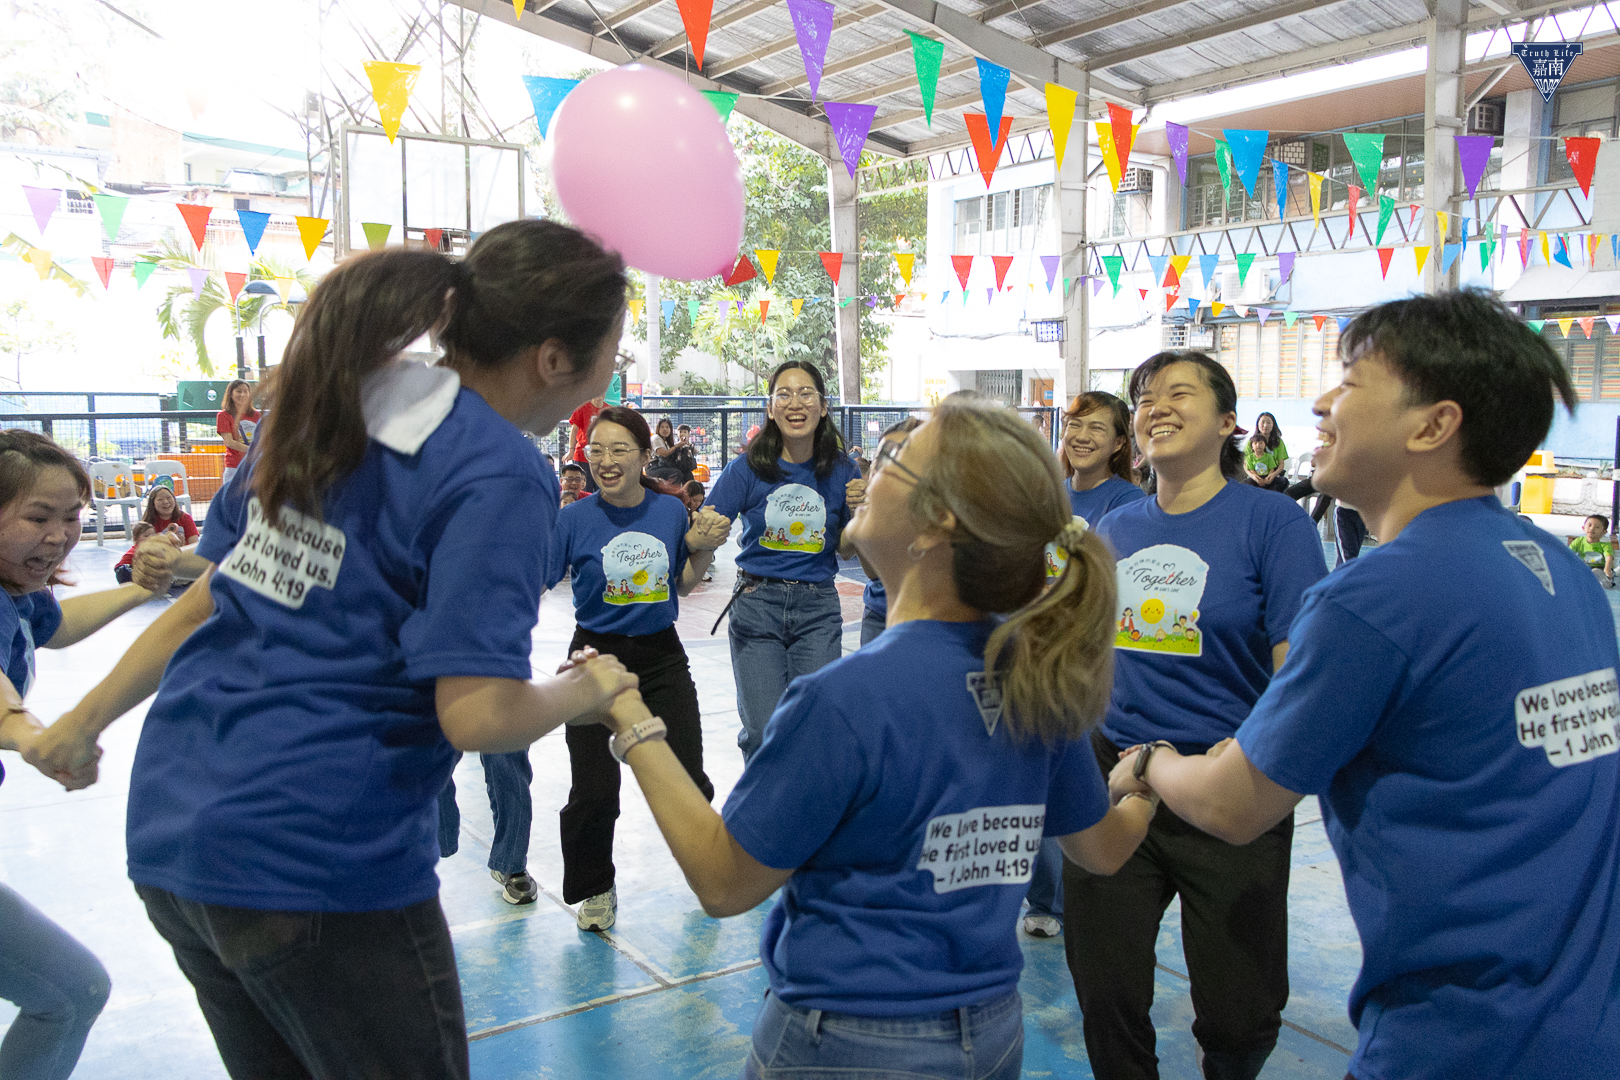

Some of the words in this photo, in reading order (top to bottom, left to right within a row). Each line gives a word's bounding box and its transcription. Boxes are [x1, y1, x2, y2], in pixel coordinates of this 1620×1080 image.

[779, 501, 821, 517] Together
[261, 534, 304, 571] loved
[305, 561, 333, 586] us.
[616, 547, 663, 567] Together
[231, 553, 267, 585] John
[271, 570, 305, 600] 4:19
[1133, 567, 1198, 591] Together
[1521, 694, 1549, 714] We
[1551, 688, 1585, 707] love
[1520, 721, 1546, 741] He
[1551, 710, 1587, 734] first
[1586, 705, 1620, 723] love
[930, 822, 952, 839] We
[974, 834, 1019, 856] loved
[995, 858, 1029, 877] 4:19
